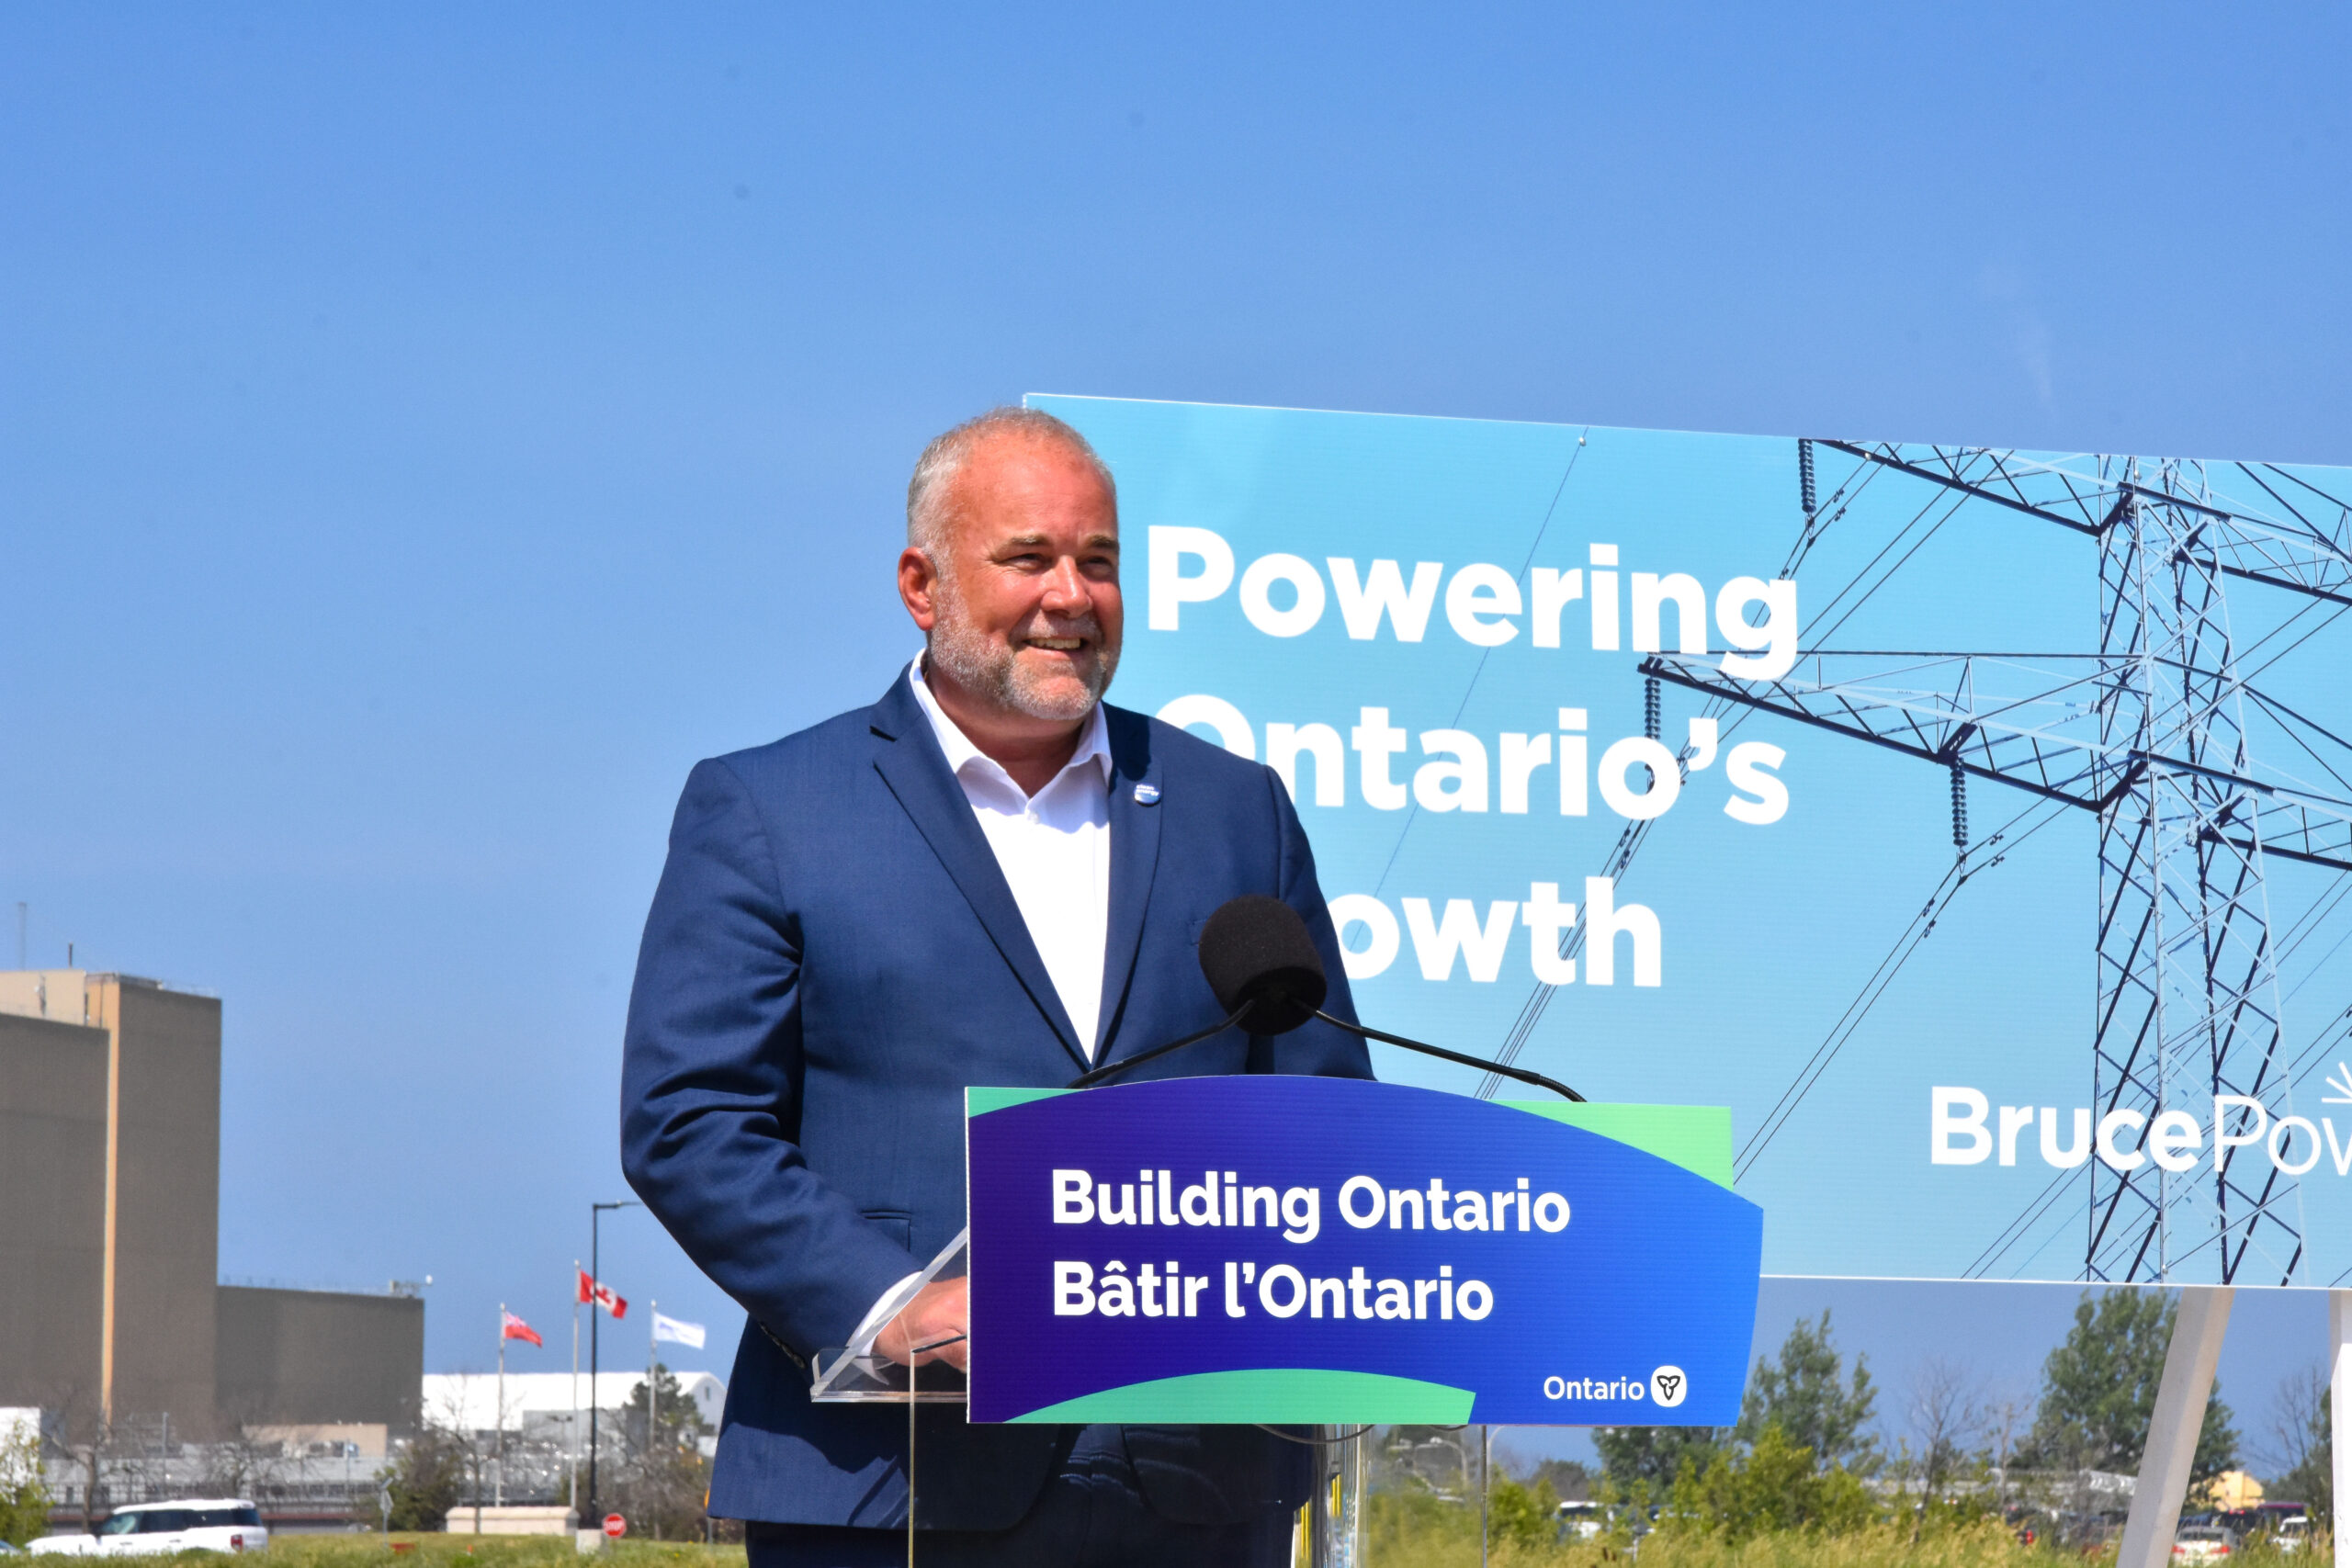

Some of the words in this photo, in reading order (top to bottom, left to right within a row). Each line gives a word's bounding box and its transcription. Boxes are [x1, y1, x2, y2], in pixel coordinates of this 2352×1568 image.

[1148, 525, 1798, 682] Powering
[1327, 876, 1662, 987] owth
[1052, 1169, 1320, 1244] Building
[1339, 1176, 1571, 1234] Ontario
[1054, 1261, 1209, 1317] Bâtir
[1226, 1262, 1494, 1321] l’Ontario
[1544, 1376, 1645, 1401] Ontario
